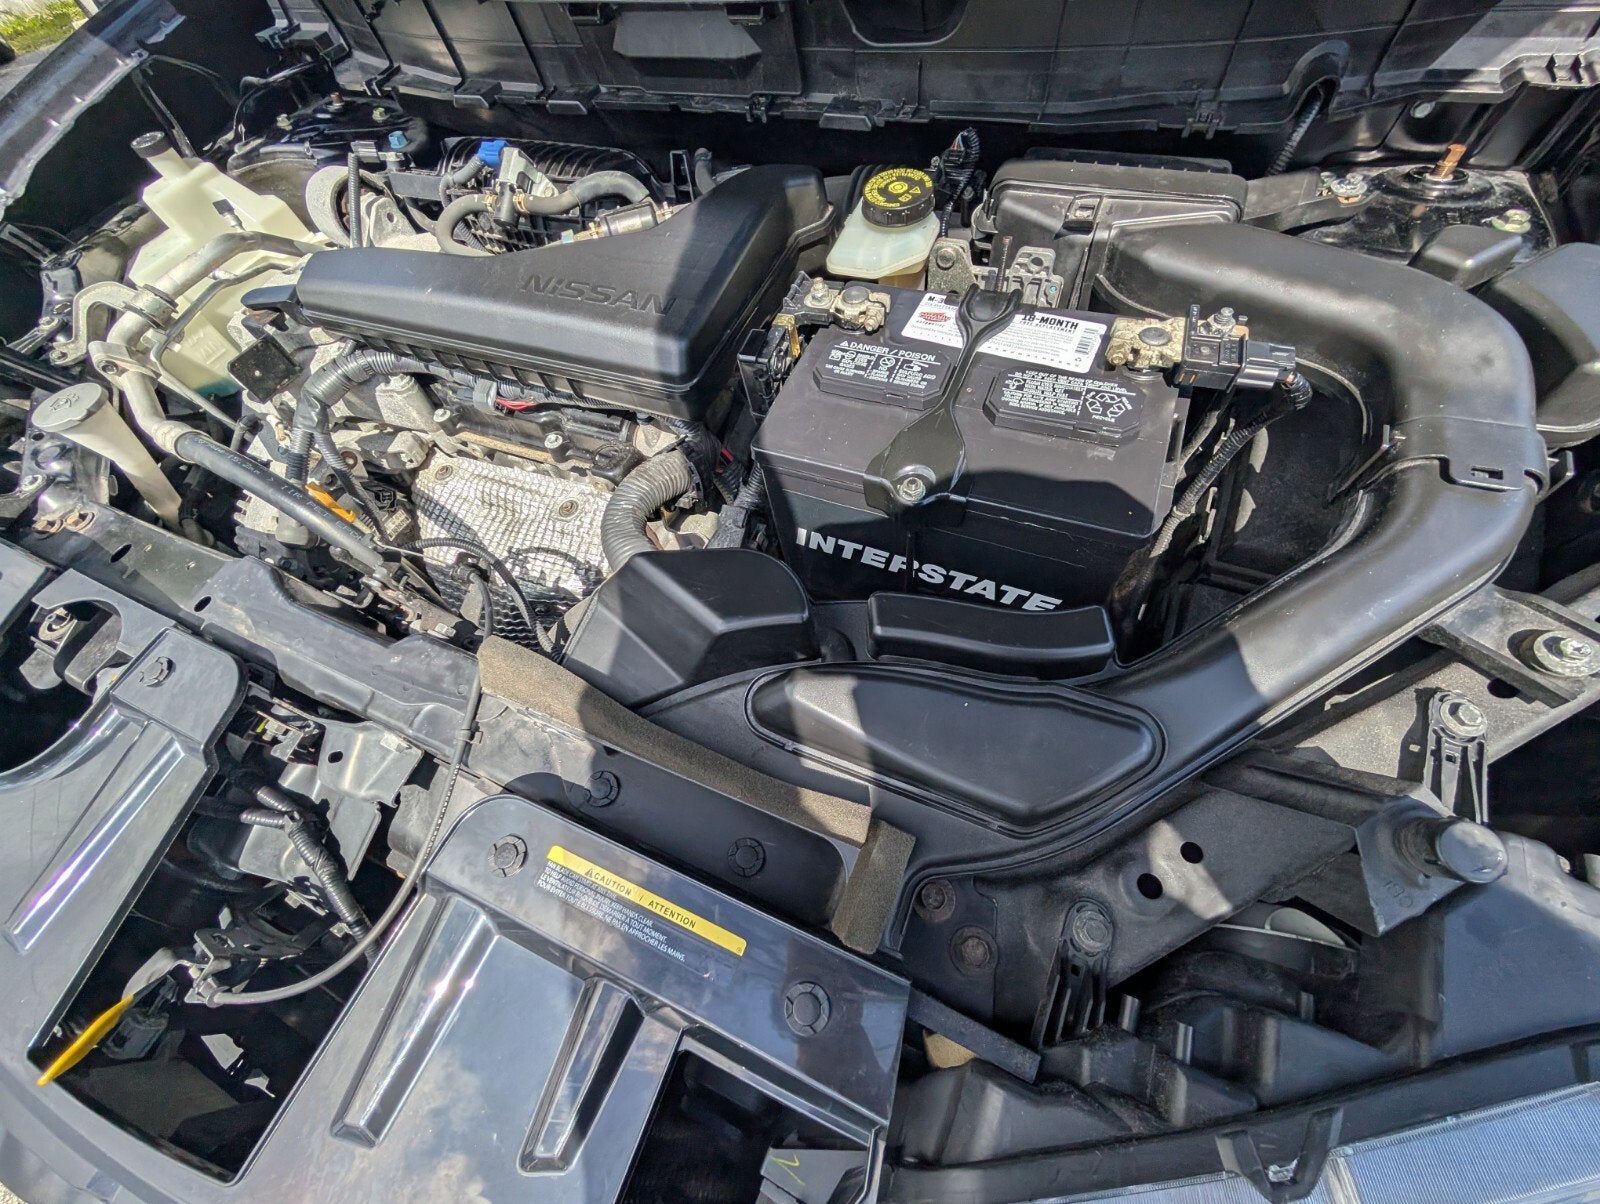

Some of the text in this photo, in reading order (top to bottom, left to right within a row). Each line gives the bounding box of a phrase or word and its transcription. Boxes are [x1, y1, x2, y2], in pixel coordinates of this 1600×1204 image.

[520, 273, 677, 316] NISSAN
[1021, 312, 1078, 330] 18-MONTH
[849, 341, 889, 353] DANGER
[898, 349, 935, 361] POISON
[795, 527, 1063, 611] INTERSTATE
[593, 871, 631, 895] CAUTION
[648, 899, 696, 928] ATTENTION
[621, 906, 638, 919] HANDS
[628, 918, 644, 930] TOUT
[627, 927, 659, 947] APPROCHER
[657, 942, 668, 952] LES
